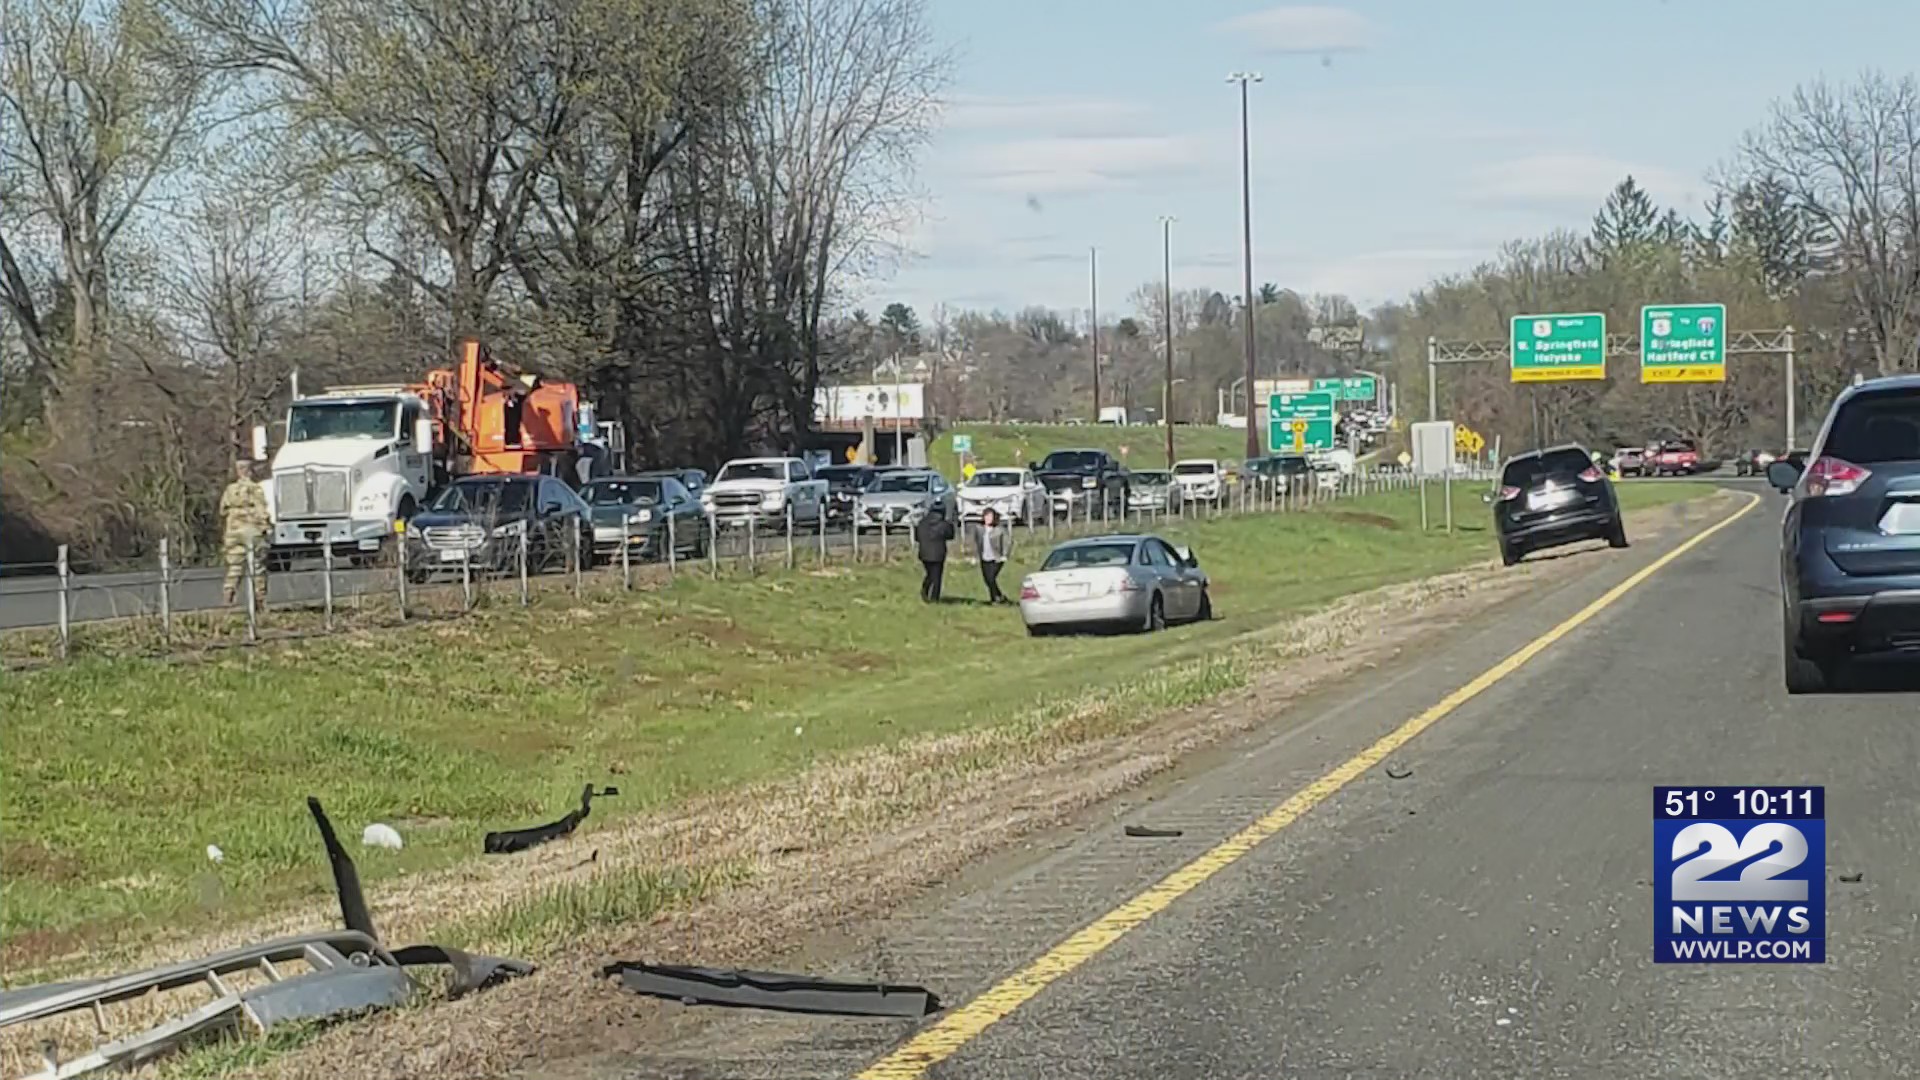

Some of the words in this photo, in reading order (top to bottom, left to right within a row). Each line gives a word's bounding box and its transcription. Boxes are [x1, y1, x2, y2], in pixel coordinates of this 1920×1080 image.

[1535, 338, 1599, 352] Springfield
[1647, 351, 1697, 362] Hartford
[1700, 350, 1716, 361] CT
